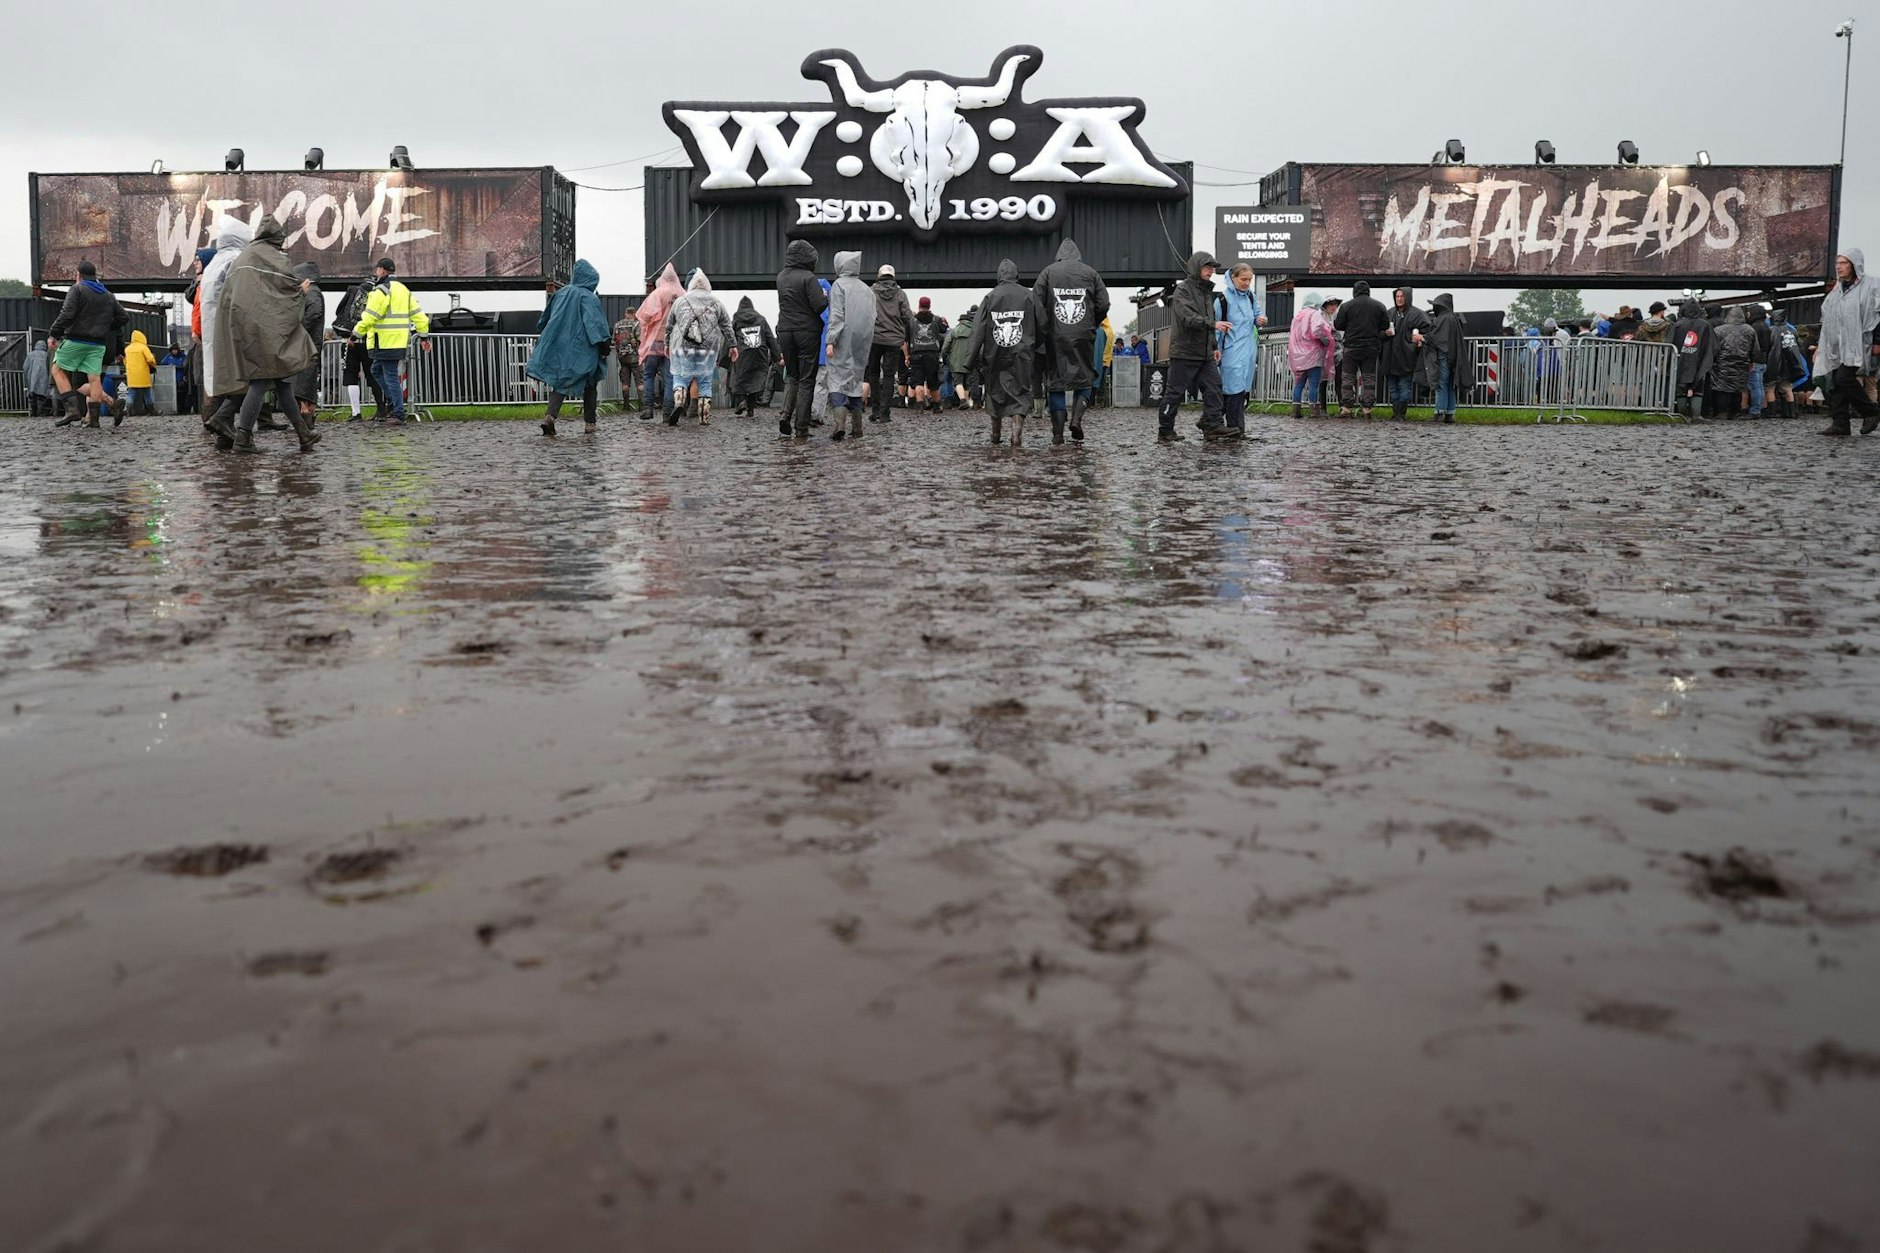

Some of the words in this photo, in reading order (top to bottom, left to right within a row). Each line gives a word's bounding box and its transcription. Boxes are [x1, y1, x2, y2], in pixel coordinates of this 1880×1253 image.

[796, 197, 902, 225] ESTD.
[949, 194, 1056, 221] 1990
[1223, 213, 1249, 223] RAIN
[1250, 213, 1304, 223] EXPECTED
[1379, 173, 1746, 272] METALHEADS
[1236, 232, 1267, 240] SECURE
[1269, 232, 1291, 240] YOUR
[1241, 241, 1267, 250] TENTS
[1267, 241, 1285, 250] AND
[1238, 251, 1289, 259] BELONGINGS
[1052, 287, 1087, 296] WACKEN
[990, 310, 1025, 320] WACKEN
